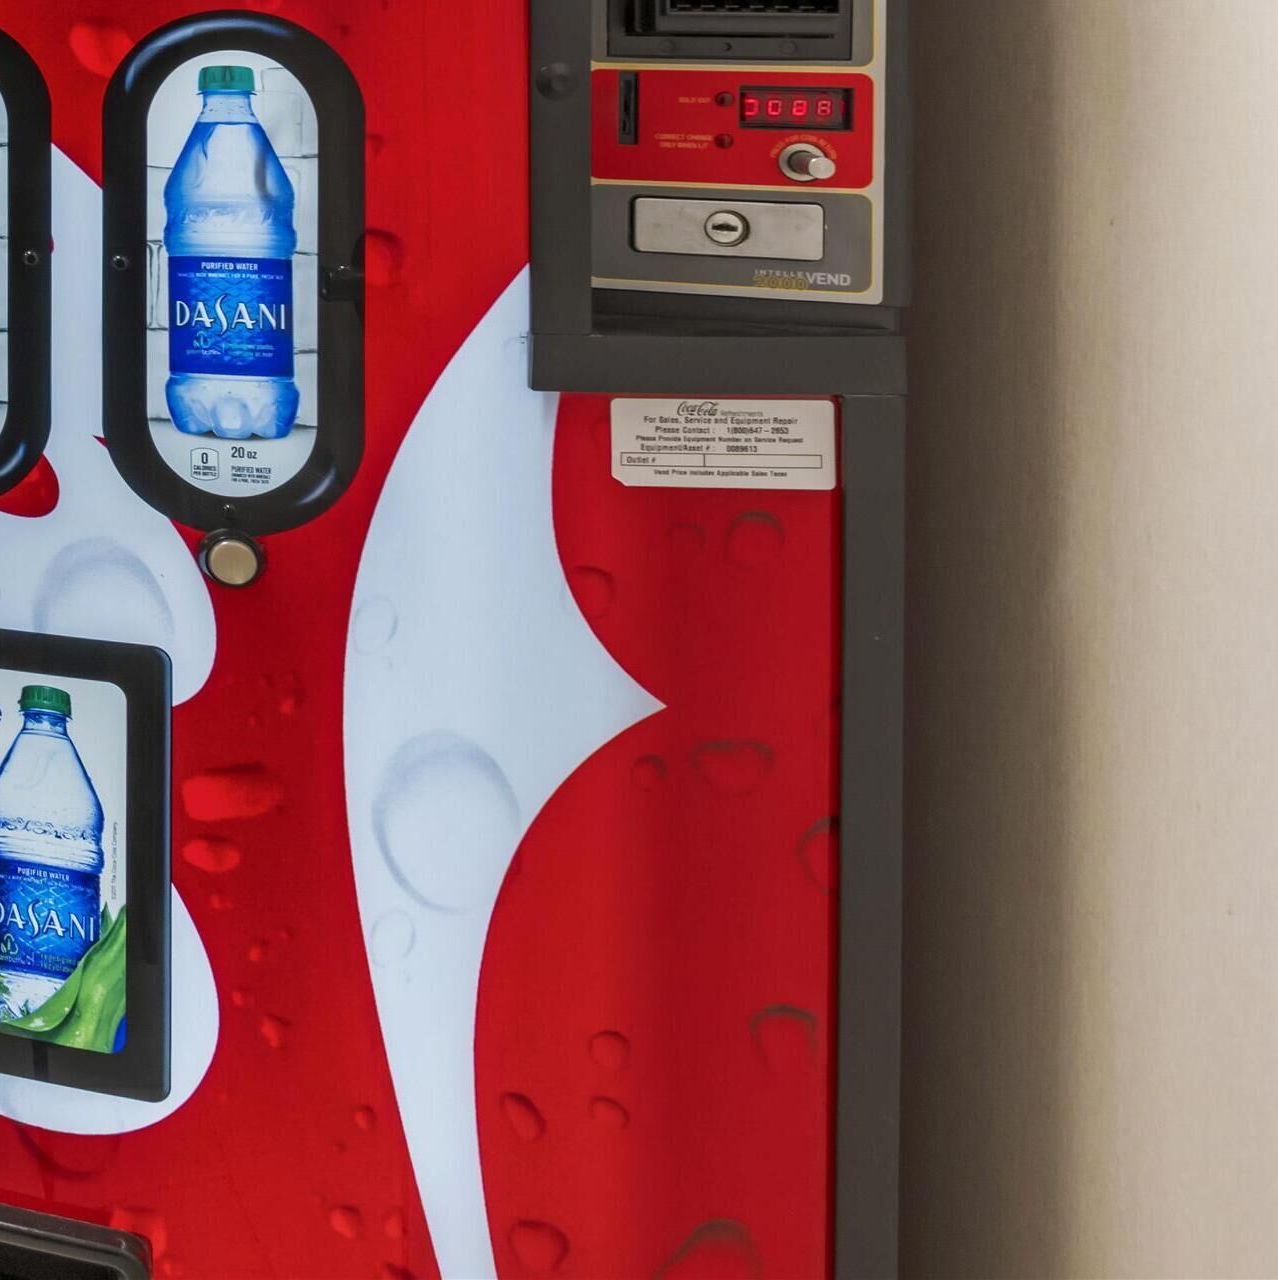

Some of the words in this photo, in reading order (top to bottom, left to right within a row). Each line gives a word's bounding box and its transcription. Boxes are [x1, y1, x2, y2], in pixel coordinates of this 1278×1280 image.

[201, 262, 234, 270] PURIFIED
[176, 294, 285, 335] DASANI
[201, 452, 208, 464] 0
[231, 446, 245, 458] 20
[247, 451, 257, 459] oz
